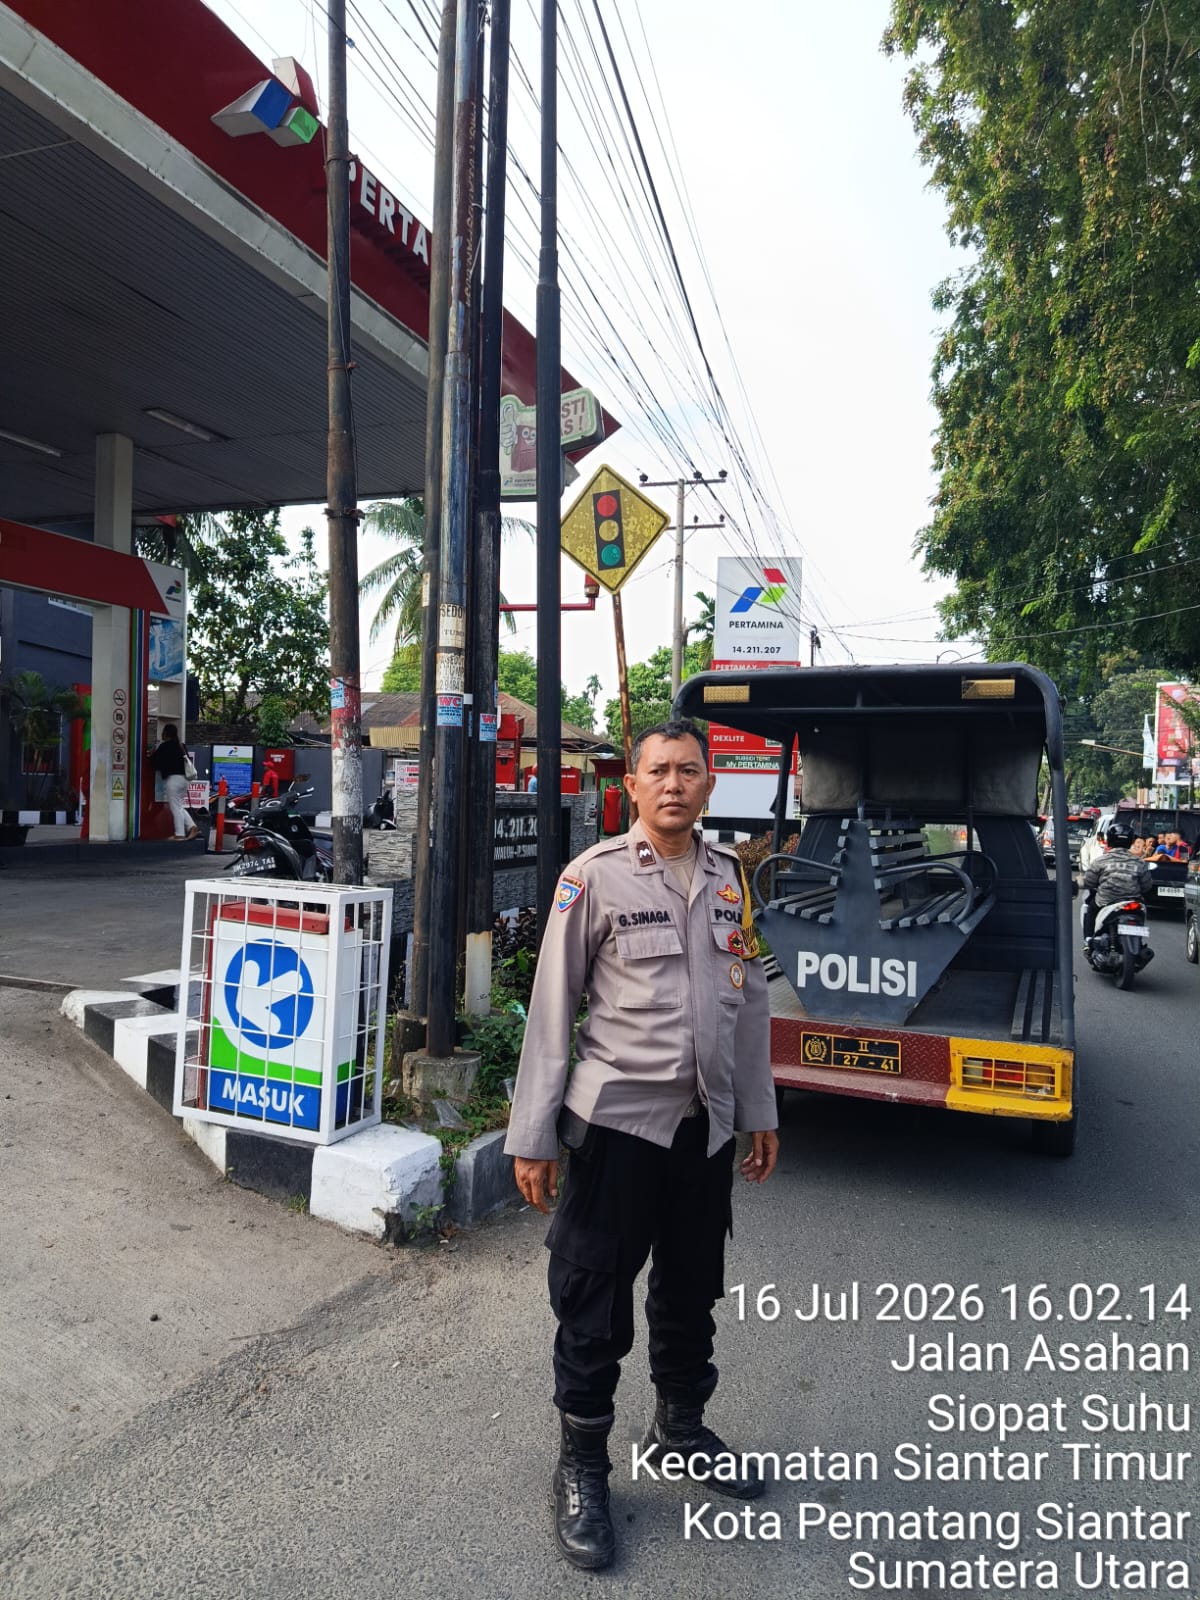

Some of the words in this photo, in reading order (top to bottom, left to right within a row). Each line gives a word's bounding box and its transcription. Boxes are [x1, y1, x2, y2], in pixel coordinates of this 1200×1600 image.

[729, 621, 784, 629] PERTAMINA
[732, 646, 782, 654] 14.211.207
[716, 664, 758, 672] PERTAMAX
[438, 696, 462, 707] WC
[618, 909, 671, 927] G.SINAGA
[797, 951, 917, 998] POLISI
[843, 1055, 860, 1066] 27
[881, 1059, 894, 1071] 41
[222, 1078, 305, 1117] MASUK
